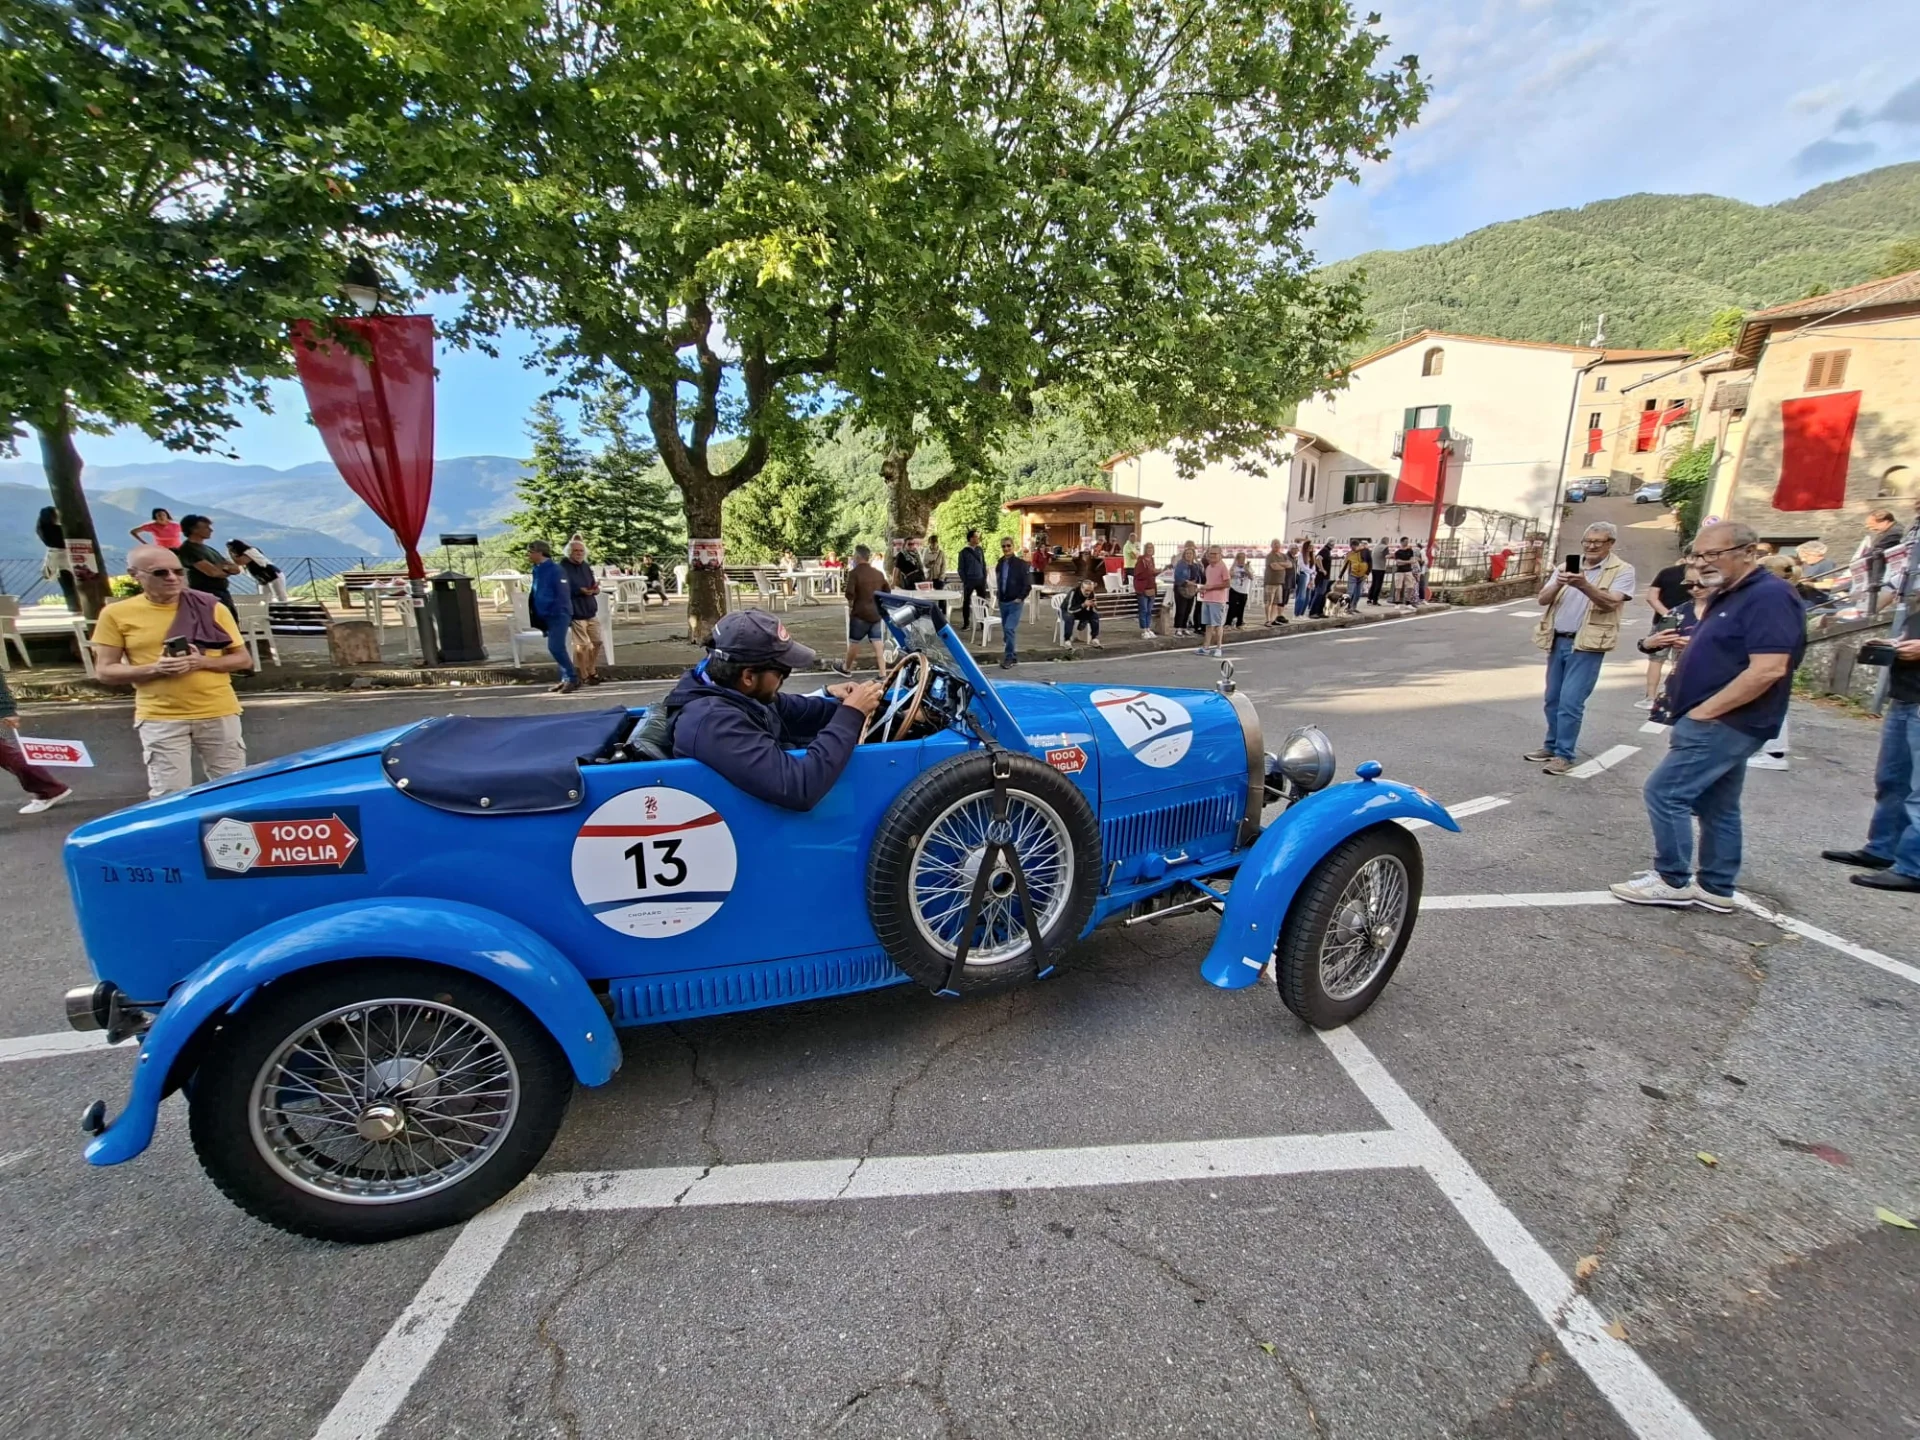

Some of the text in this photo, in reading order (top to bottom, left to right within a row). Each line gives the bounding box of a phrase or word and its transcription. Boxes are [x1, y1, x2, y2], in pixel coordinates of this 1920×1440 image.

[1125, 700, 1168, 731] 13
[25, 744, 69, 752] MIGLIA
[32, 752, 70, 760] 1000
[1051, 750, 1076, 762] 1000
[271, 824, 331, 841] 1000
[270, 844, 339, 862] MIGLIA
[624, 838, 688, 890] 13
[101, 866, 120, 883] ZA
[126, 867, 155, 883] 393
